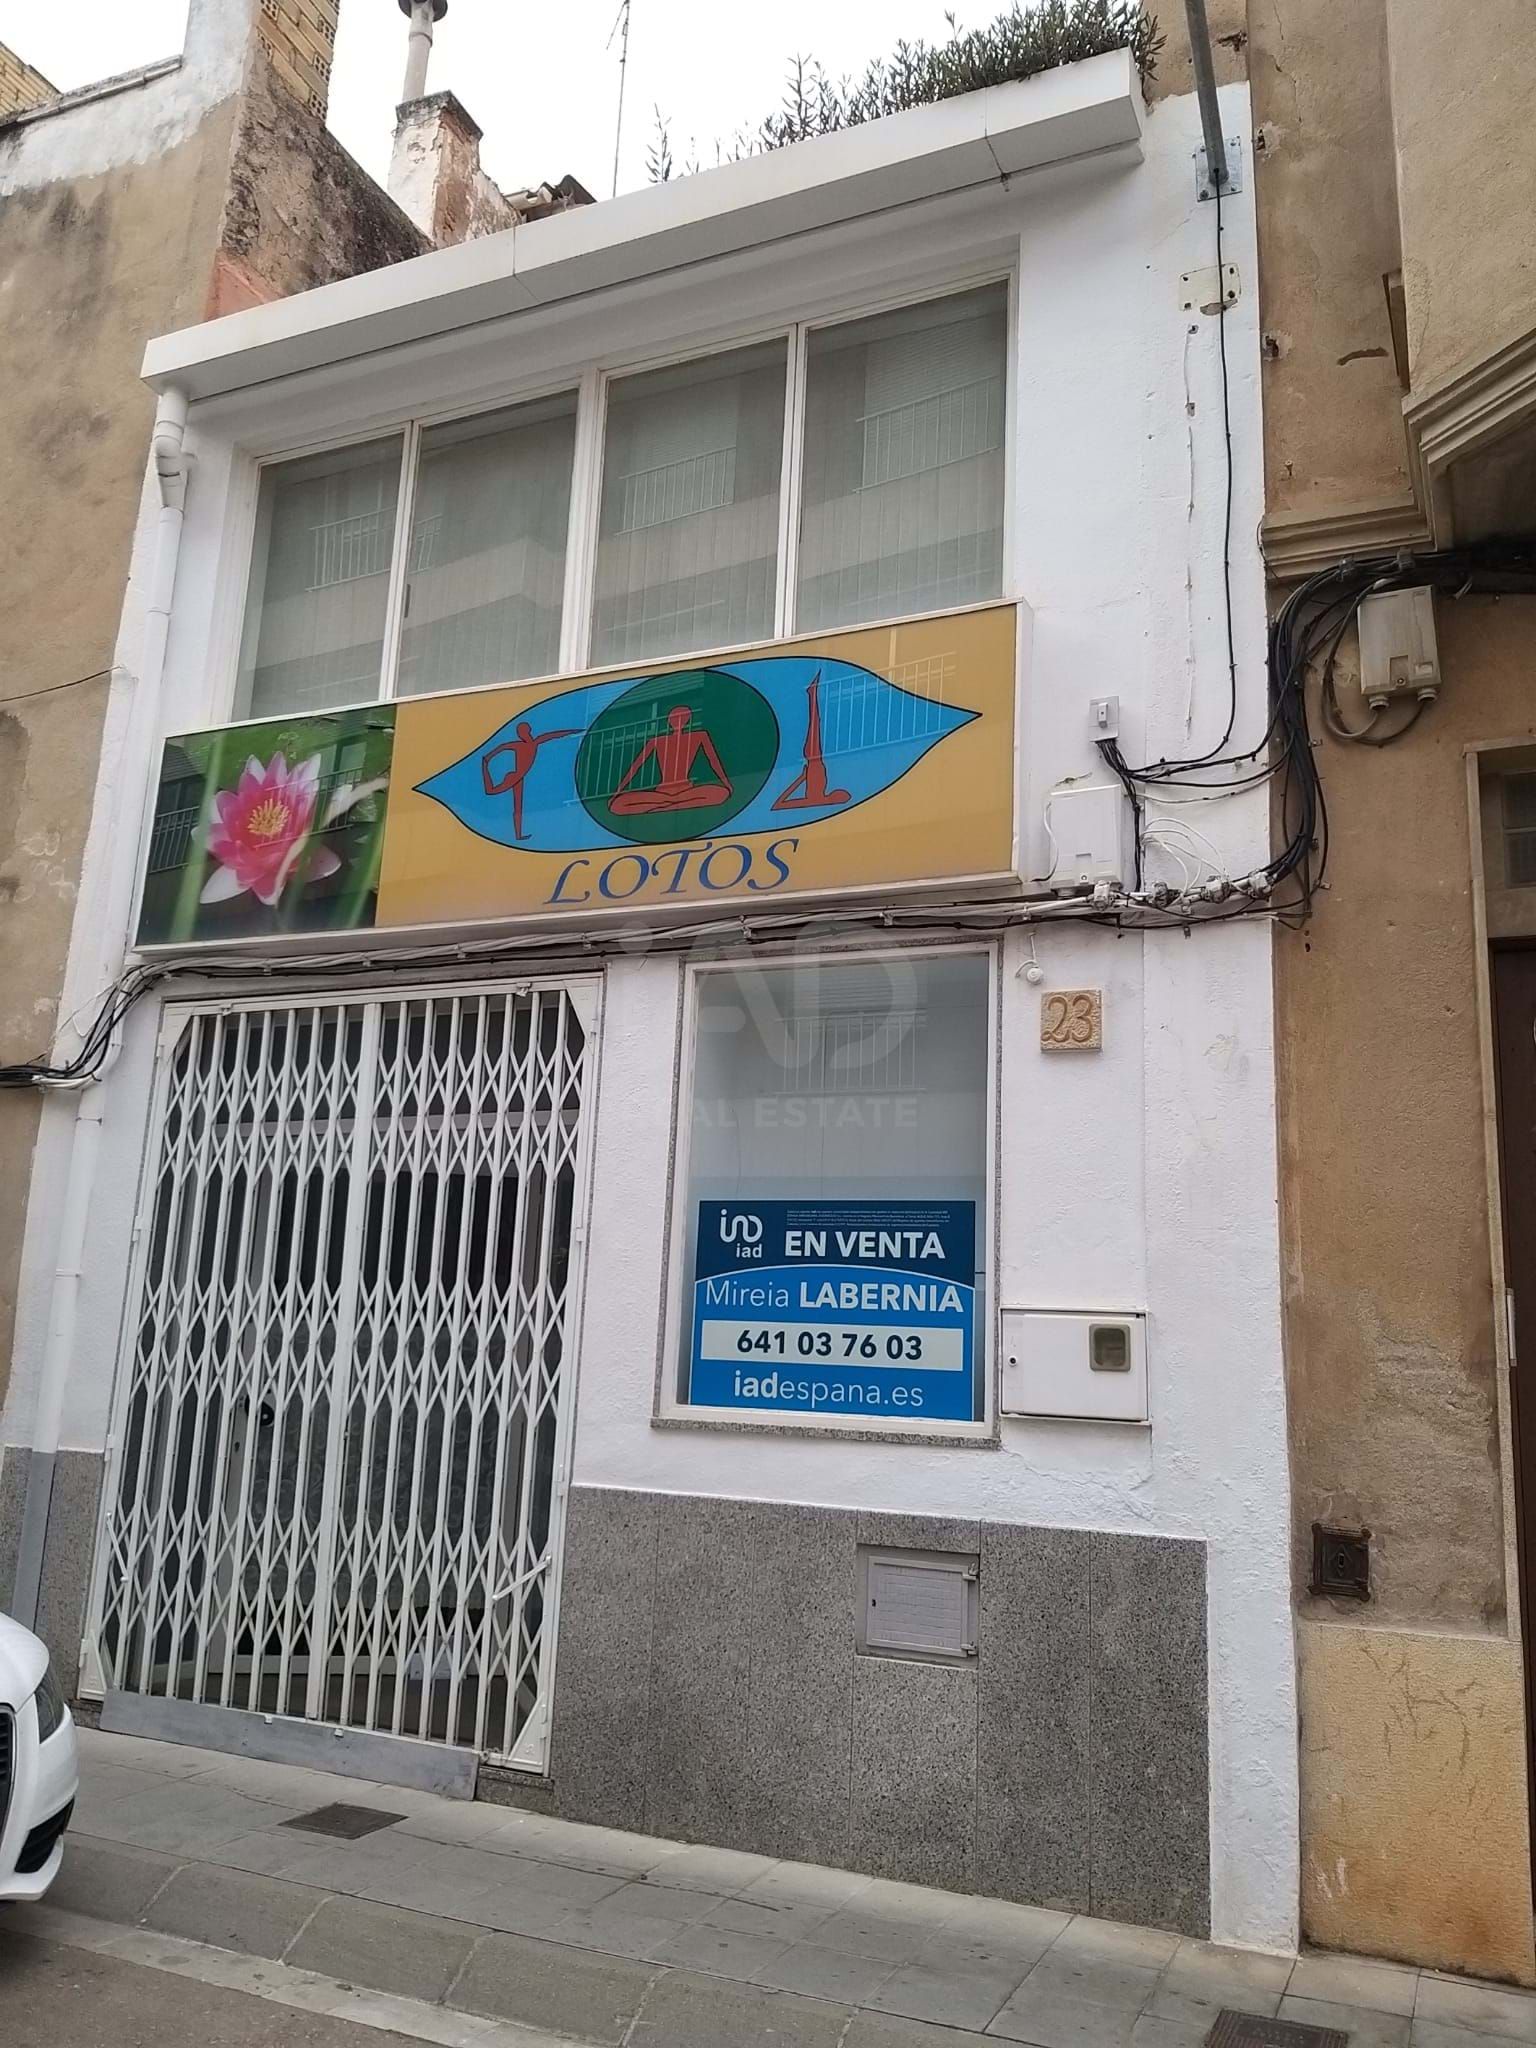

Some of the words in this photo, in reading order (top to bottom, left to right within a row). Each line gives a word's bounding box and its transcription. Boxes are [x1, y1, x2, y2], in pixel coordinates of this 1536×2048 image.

[543, 838, 800, 905] LOTOS
[1041, 994, 1094, 1043] 23
[736, 1243, 763, 1258] iad
[784, 1230, 827, 1257] EN
[835, 1231, 946, 1259] VENTA
[705, 1279, 789, 1308] Mireia
[799, 1281, 964, 1313] LABERNIA
[736, 1329, 785, 1353] 641
[797, 1331, 832, 1357] 03
[841, 1333, 877, 1359] 76
[886, 1334, 922, 1360] 03
[733, 1369, 924, 1409] iadespana.es
